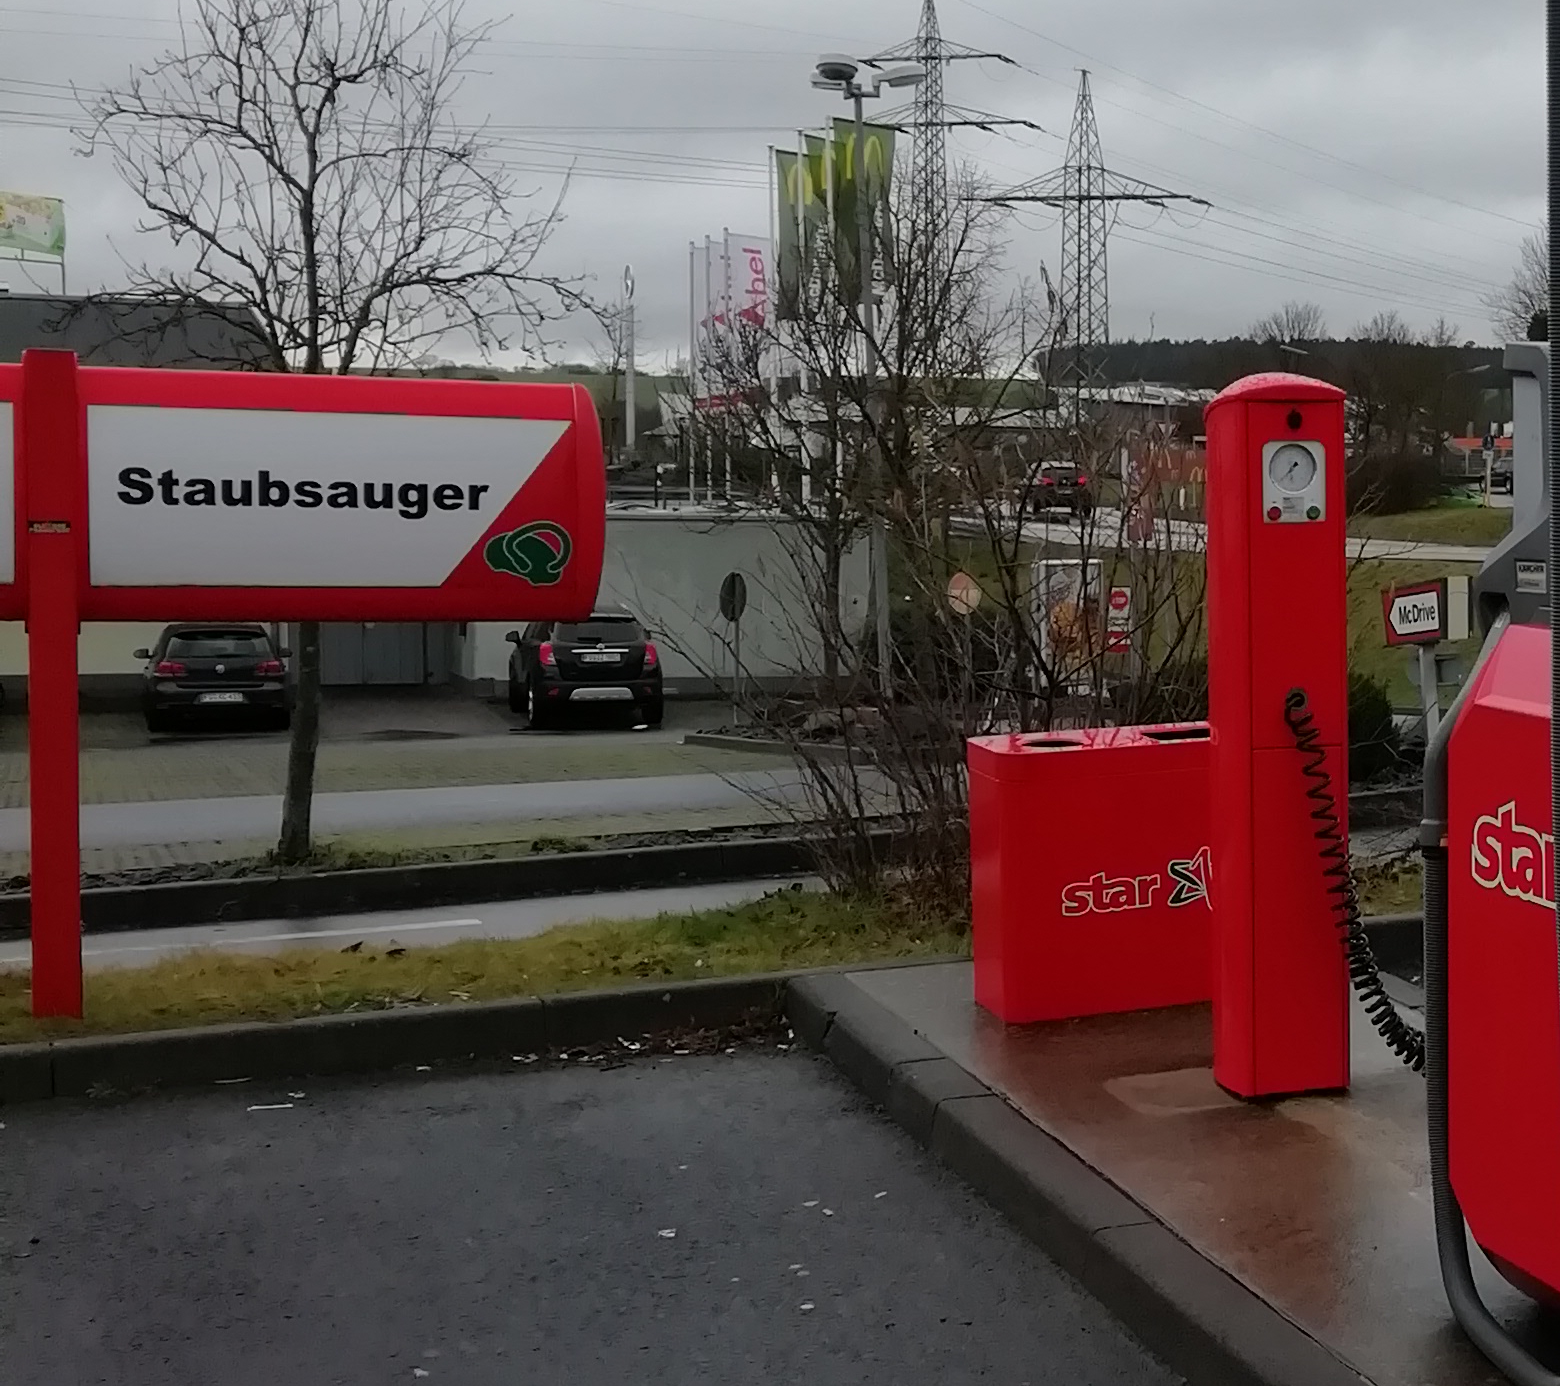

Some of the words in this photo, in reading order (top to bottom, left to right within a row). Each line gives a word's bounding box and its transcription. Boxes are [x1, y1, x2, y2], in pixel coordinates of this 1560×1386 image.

[117, 466, 490, 520] Staubsauger
[1398, 602, 1436, 625] McDrive
[1061, 871, 1161, 917] star
